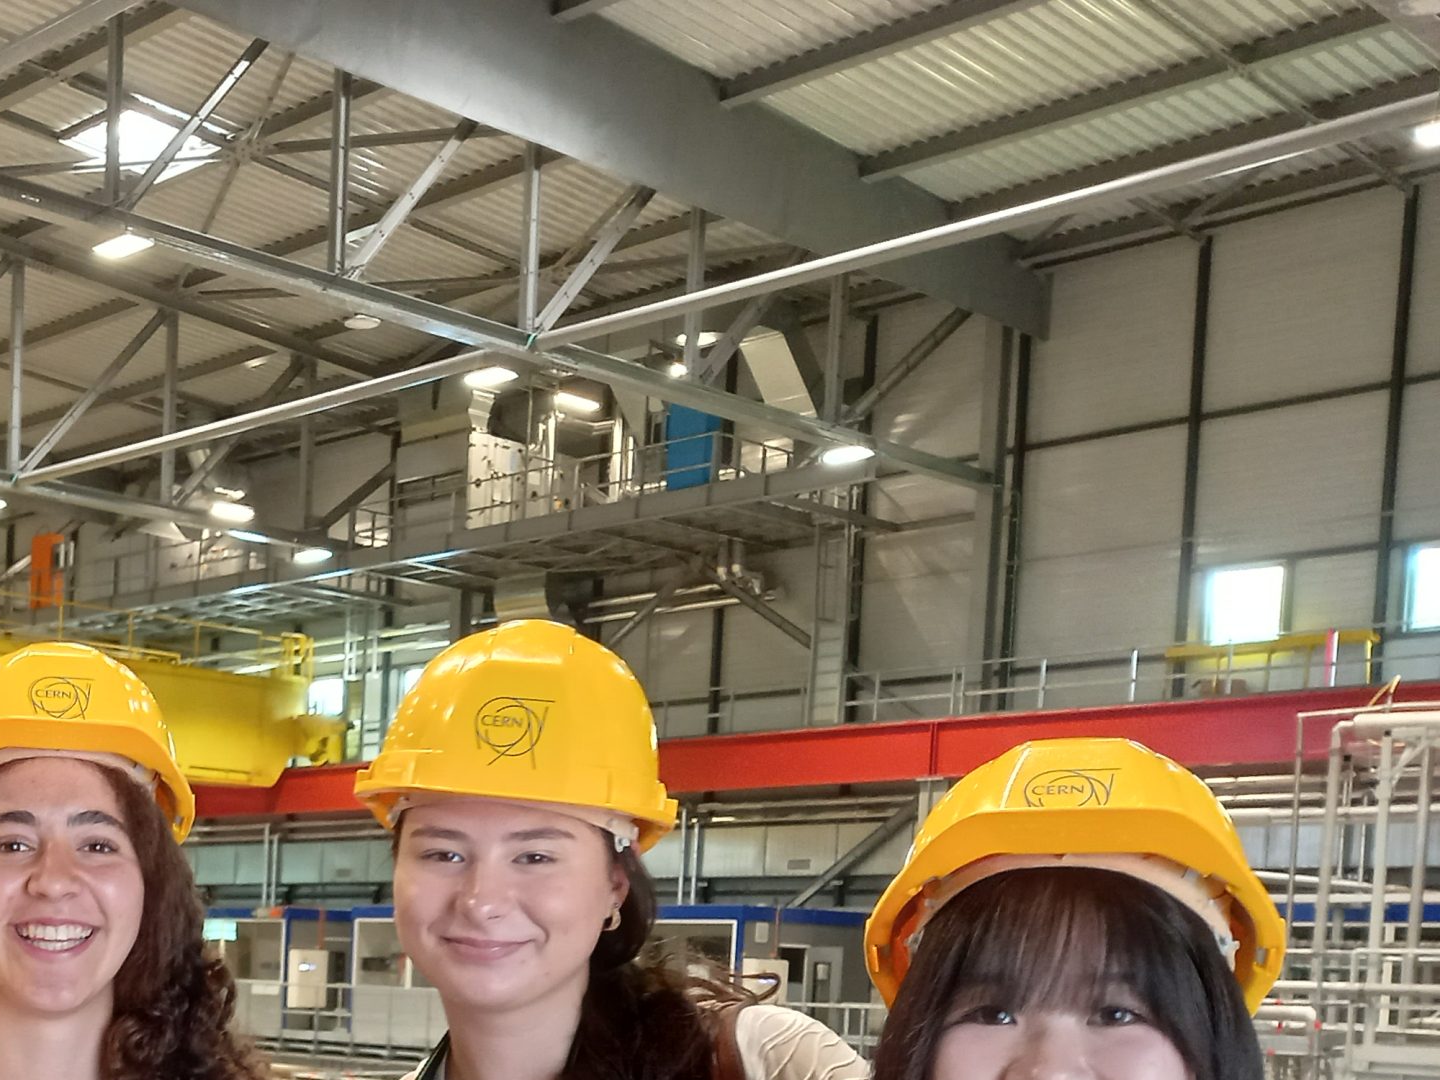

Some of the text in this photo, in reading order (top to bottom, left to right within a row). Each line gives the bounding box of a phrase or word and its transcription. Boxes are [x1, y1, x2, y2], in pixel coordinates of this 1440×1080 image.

[35, 689, 71, 699] CERN
[481, 714, 523, 728] CERN
[1032, 784, 1084, 796] CERN
